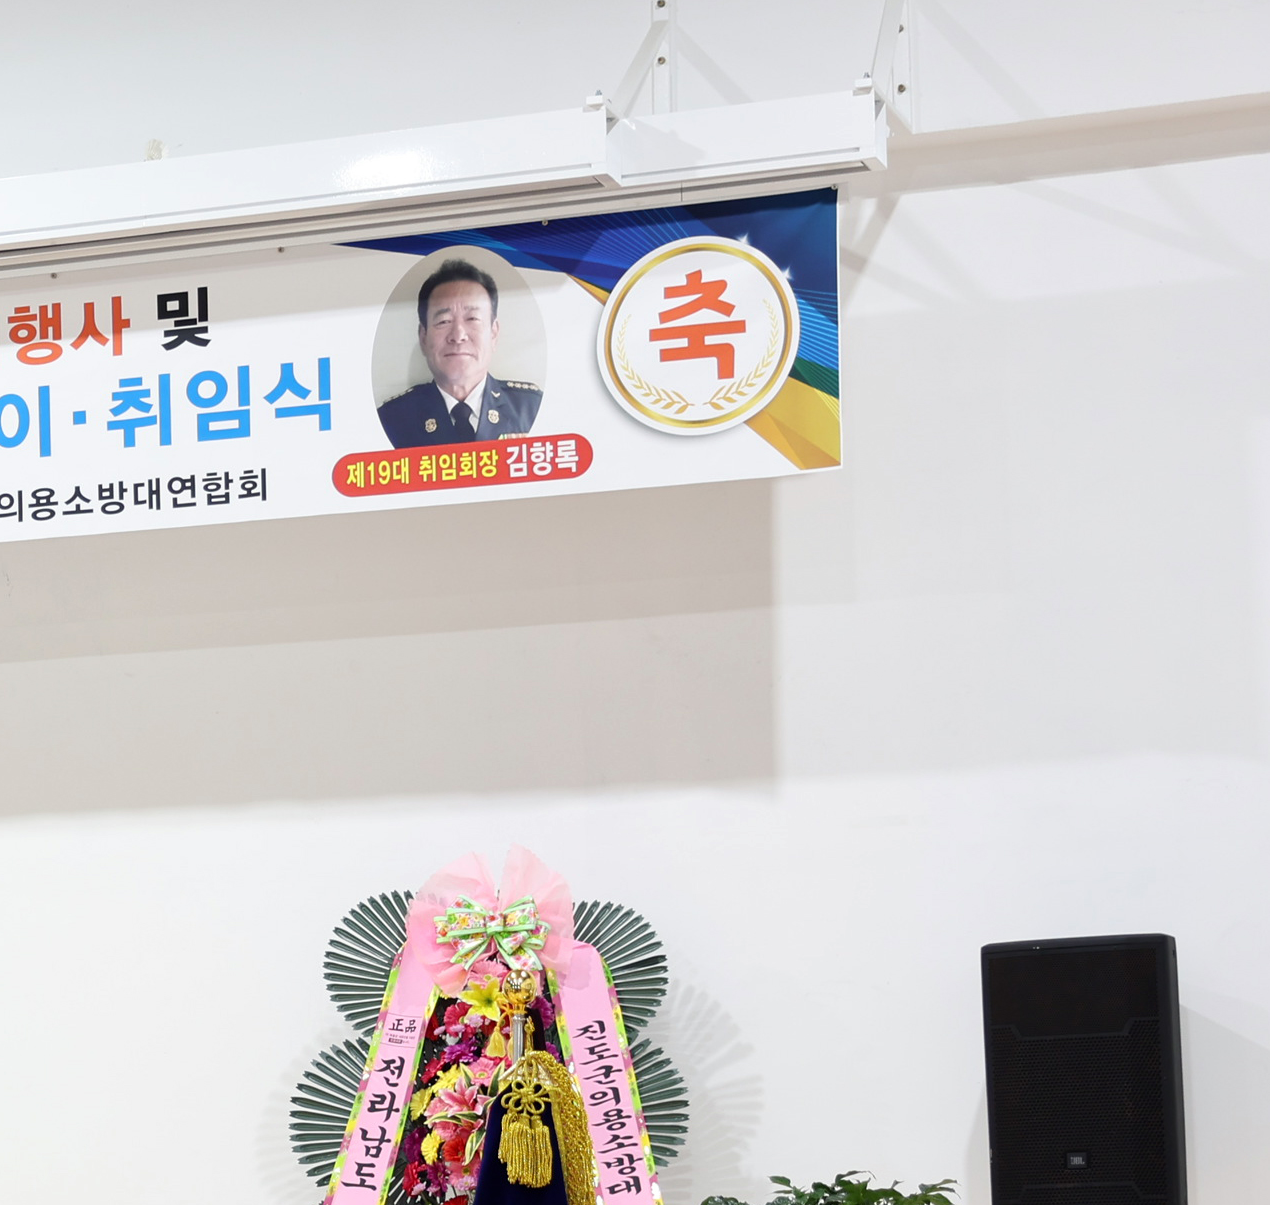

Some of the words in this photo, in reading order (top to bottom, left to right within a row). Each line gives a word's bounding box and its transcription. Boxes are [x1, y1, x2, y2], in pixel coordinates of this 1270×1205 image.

[156, 286, 212, 351] 및
[649, 269, 747, 379] 축
[346, 457, 410, 488] 제19대
[418, 449, 499, 482] 취임회장
[506, 439, 579, 478] 김향록
[388, 1018, 417, 1033] 正品
[341, 1055, 406, 1191] 전라남도
[573, 1020, 642, 1195] 진도군의용소방대
